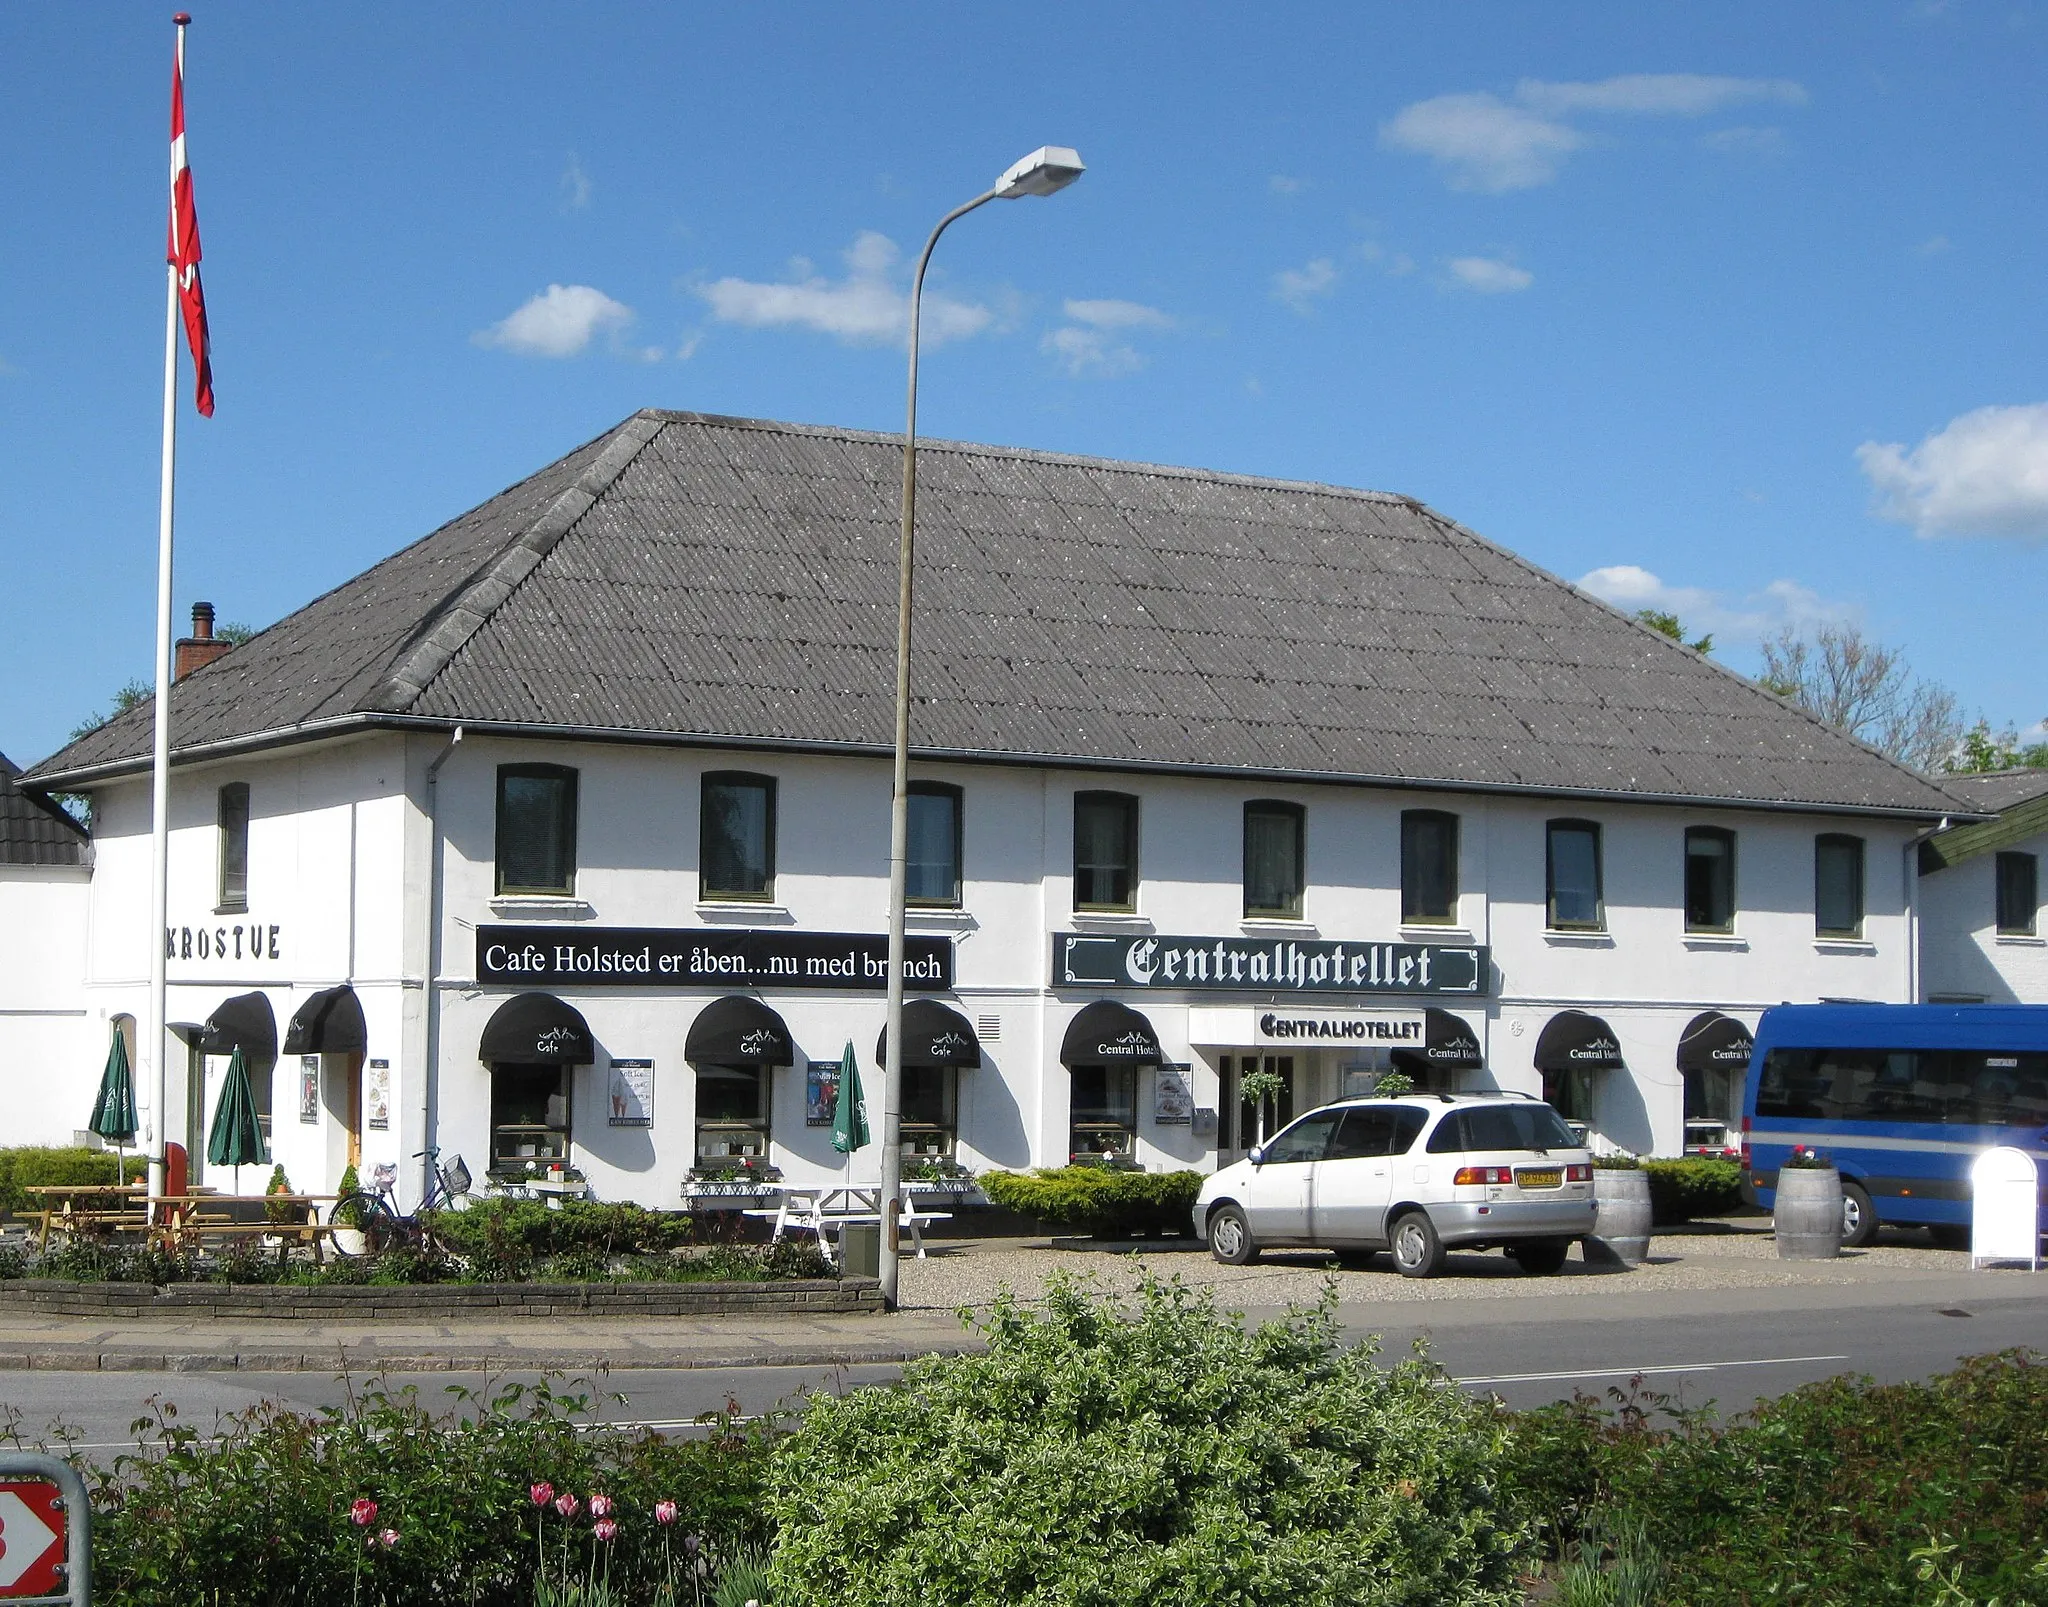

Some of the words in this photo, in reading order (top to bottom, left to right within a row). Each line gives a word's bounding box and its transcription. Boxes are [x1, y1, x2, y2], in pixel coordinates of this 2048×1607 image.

[166, 924, 280, 960] KROSTUE
[485, 945, 546, 972] Cafe
[553, 946, 650, 973] Holsted
[658, 954, 683, 973] er
[805, 951, 856, 976] med
[863, 952, 943, 978] brnch
[1126, 938, 1432, 988] Centralhotellet
[1261, 1013, 1422, 1040] CENTRALHOTELLET
[537, 1040, 559, 1054] Cafe
[740, 1042, 762, 1055] Cafe
[931, 1044, 952, 1057] Cafe
[1098, 1043, 1134, 1055] Central
[1428, 1048, 1461, 1058] Central
[1570, 1049, 1603, 1059] Central
[1712, 1049, 1743, 1059] Central
